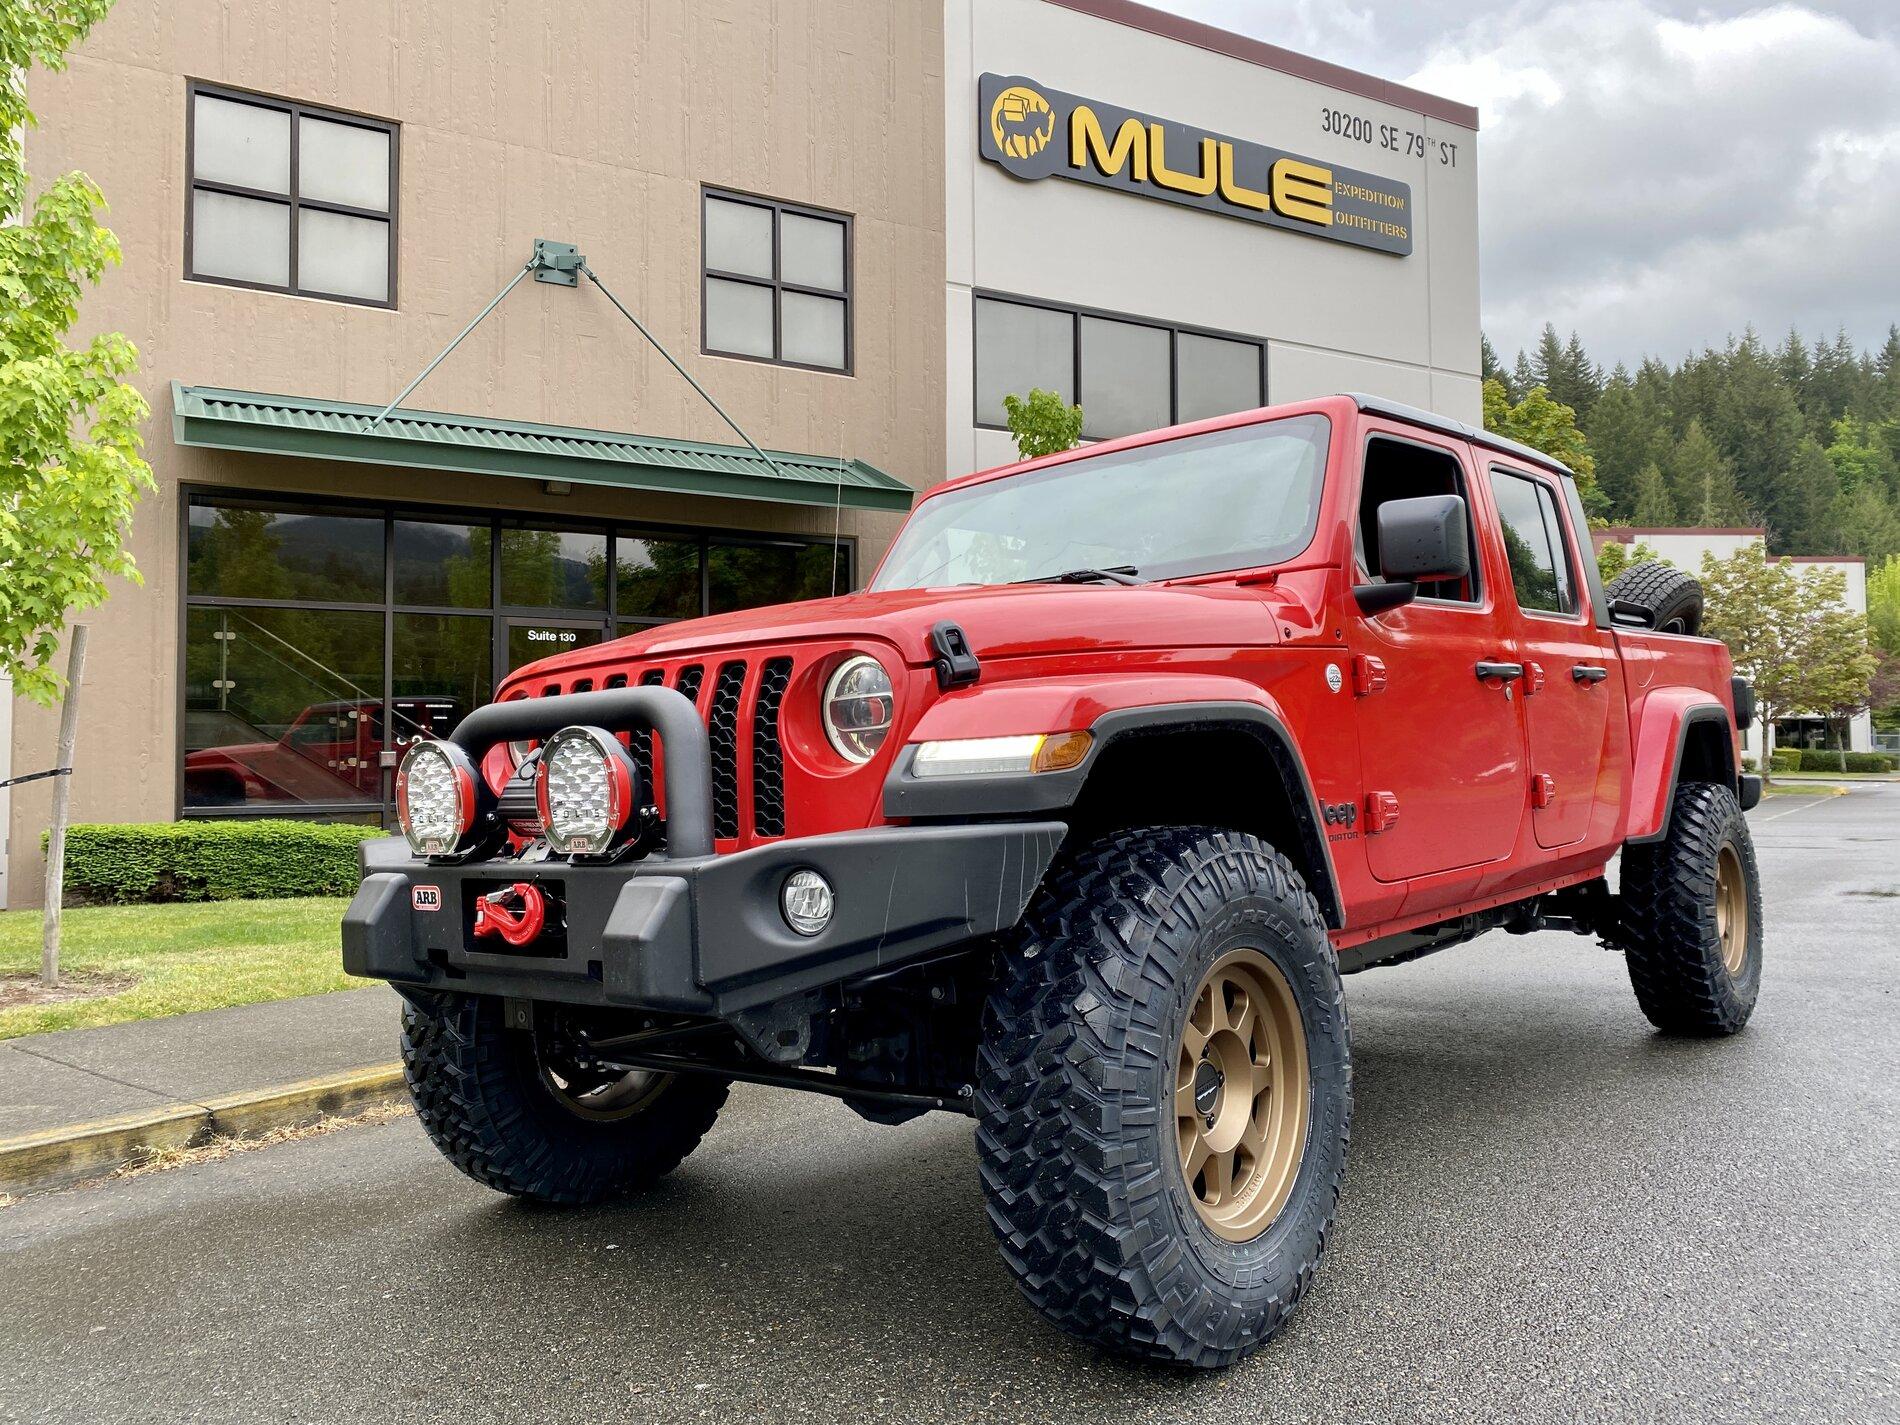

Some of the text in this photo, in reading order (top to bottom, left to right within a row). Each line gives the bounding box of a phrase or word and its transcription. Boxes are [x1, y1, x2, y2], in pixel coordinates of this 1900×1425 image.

[1321, 107, 1373, 144] 30200
[1380, 124, 1400, 152] SE
[1440, 141, 1458, 168] ST
[1070, 105, 1334, 226] MULE
[1335, 181, 1405, 210] EXPEDITION
[1335, 211, 1408, 240] OUTFITTERS
[527, 629, 577, 643] Suite 130
[552, 808, 600, 819] SOLIS
[573, 840, 586, 848] ARB
[1328, 831, 1360, 843] DIATOR
[416, 890, 438, 905] ARB
